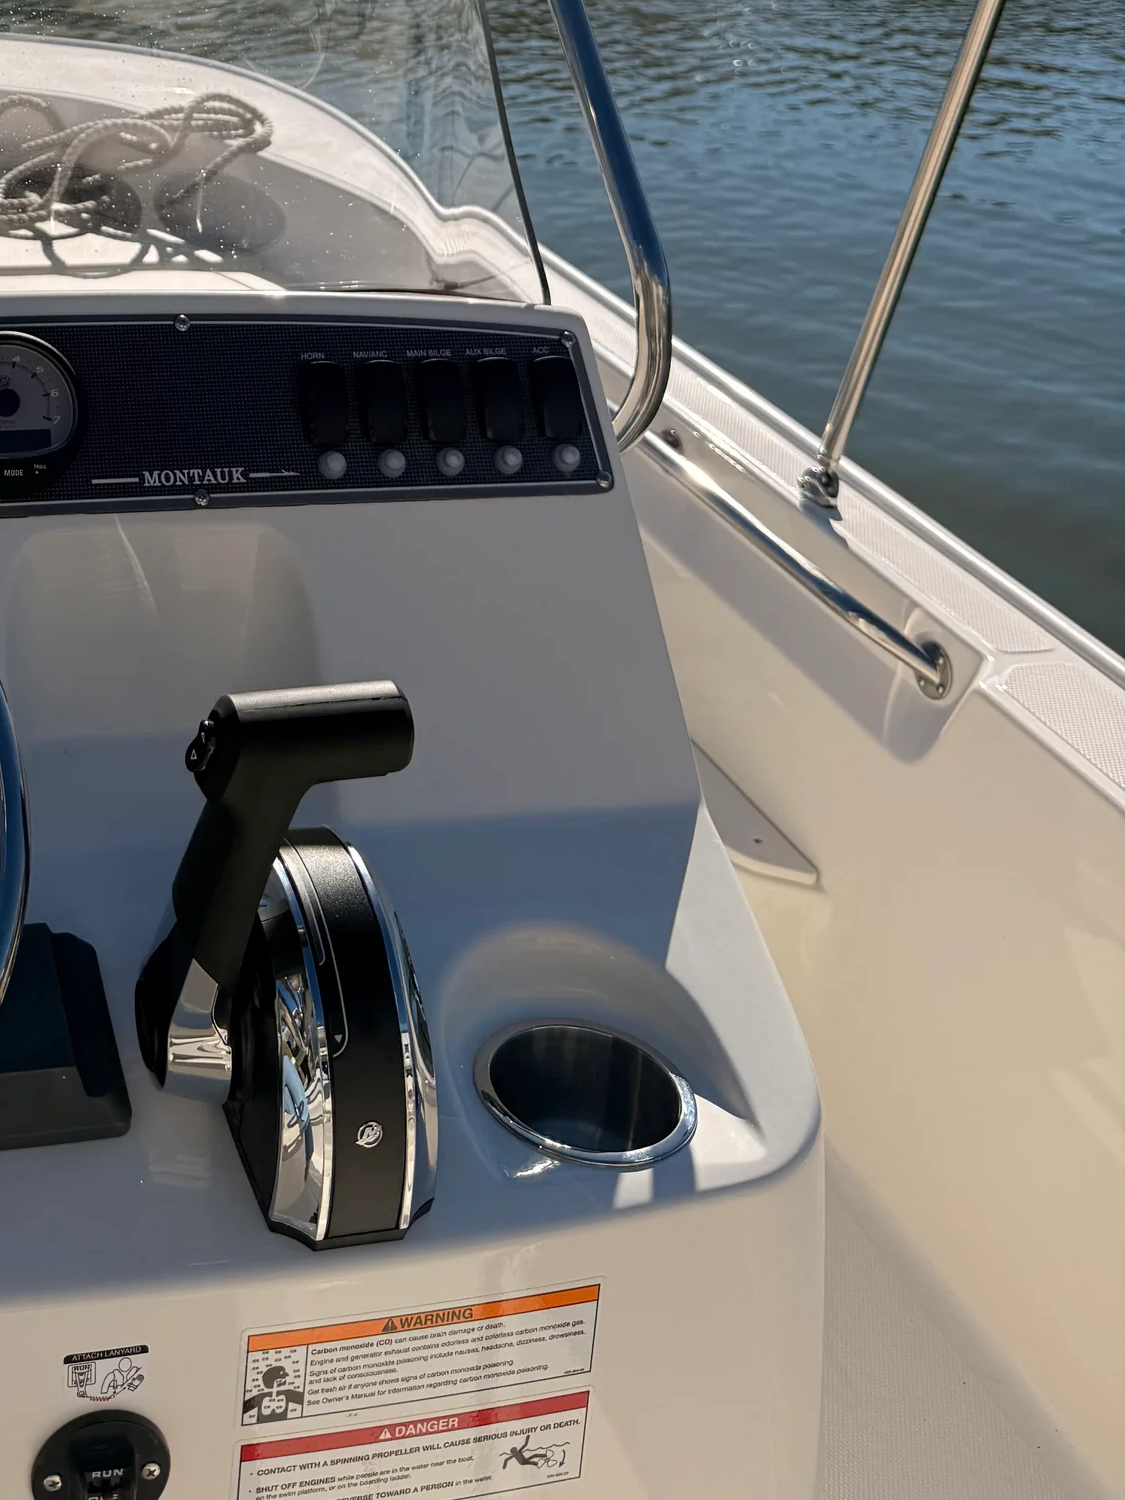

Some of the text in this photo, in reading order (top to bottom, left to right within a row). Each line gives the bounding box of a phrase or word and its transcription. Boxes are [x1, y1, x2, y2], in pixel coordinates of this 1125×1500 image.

[301, 352, 325, 360] HORN
[465, 348, 481, 356] AUX
[533, 346, 549, 354] ACC
[51, 389, 59, 397] 6
[53, 416, 61, 424] 7
[143, 468, 247, 486] MONTAUK
[399, 1308, 473, 1329] WARNING
[71, 1346, 141, 1362] ATTACH LANYARD
[395, 1418, 459, 1437] DANGER
[256, 1465, 298, 1476] CONTACT
[299, 1462, 321, 1470] WITH
[330, 1454, 370, 1466] SPINNING
[371, 1447, 420, 1459] PROPELLER
[443, 1438, 471, 1448] CAUSE
[472, 1432, 508, 1443] SERIOUS
[509, 1426, 539, 1437] INJURY
[553, 1419, 581, 1429] DEATH.
[91, 1468, 123, 1478] RUN
[255, 1477, 336, 1494] SHUT OFF ENGINES
[376, 1488, 411, 1498] TOWARD
[420, 1481, 454, 1492] PERSON
